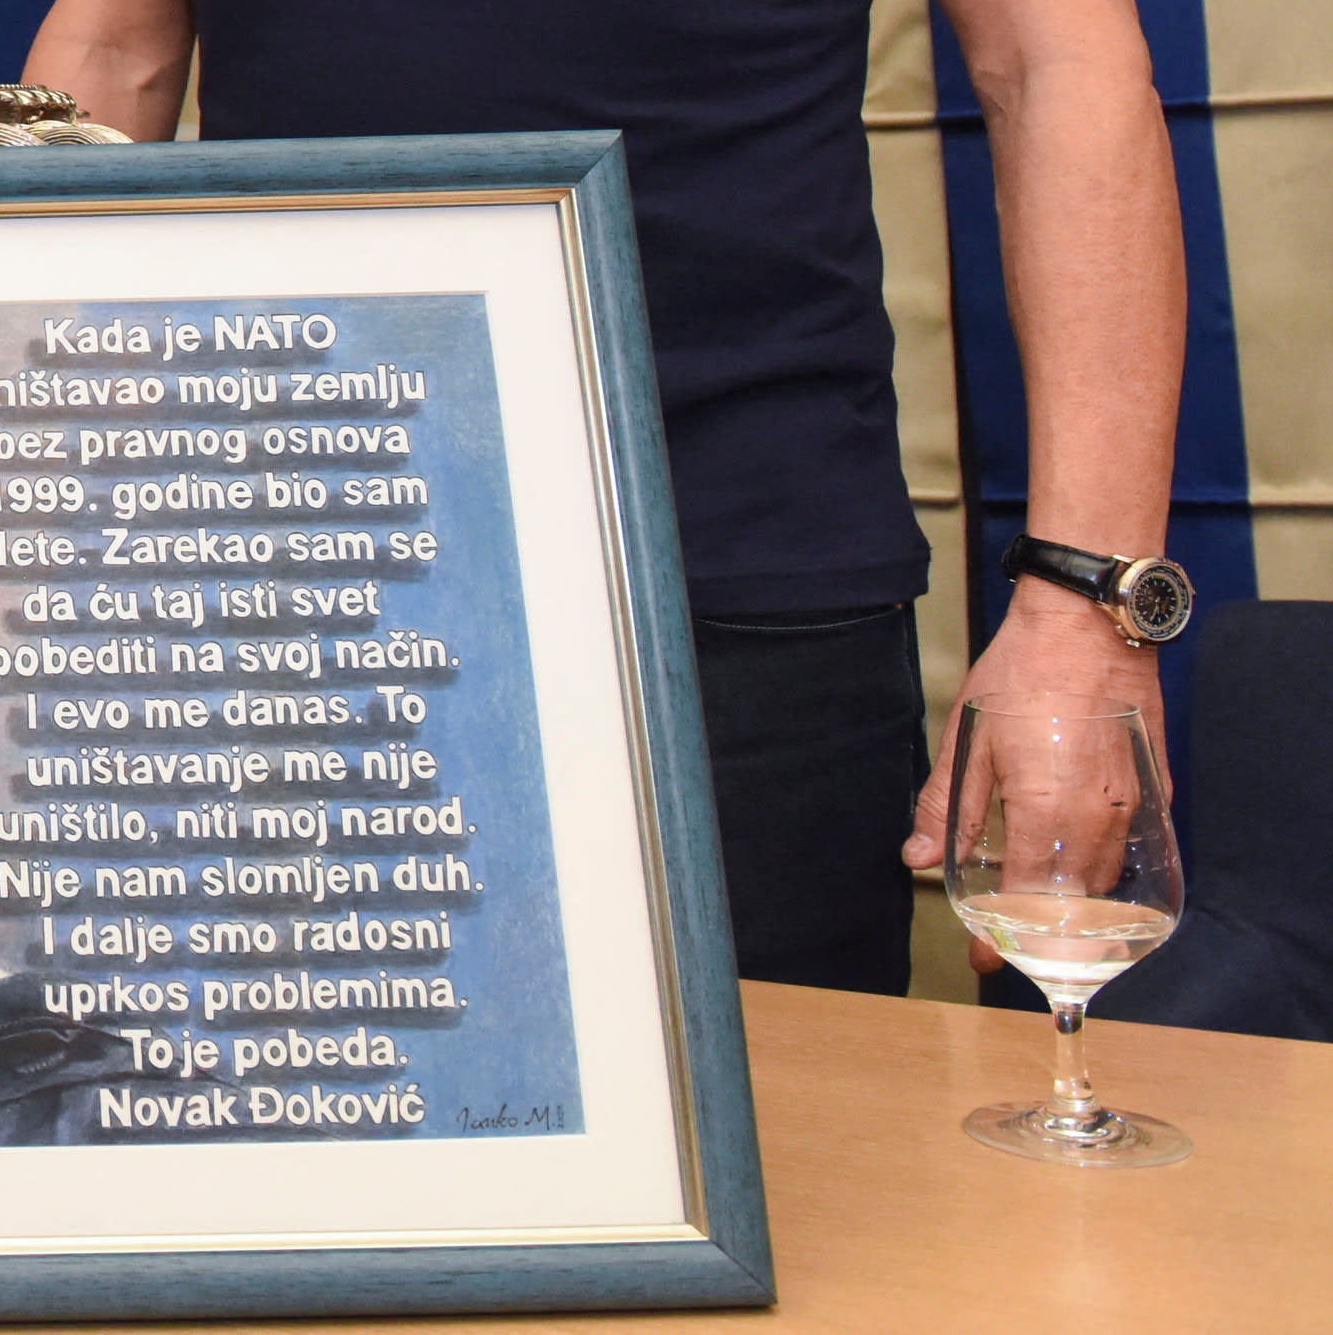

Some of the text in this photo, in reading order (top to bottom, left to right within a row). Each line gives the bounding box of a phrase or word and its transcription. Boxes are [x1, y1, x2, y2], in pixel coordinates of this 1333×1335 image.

[44, 313, 337, 362] Kada je NATO
[178, 368, 277, 411] moju
[290, 363, 426, 409] zemlju
[79, 428, 247, 466] pravnog
[263, 424, 411, 455] osnova
[112, 473, 253, 520] godine
[265, 471, 327, 509] bio
[343, 476, 428, 506] sam
[101, 527, 273, 565] Zarekao
[287, 531, 375, 561] sam
[389, 531, 437, 561] se
[22, 580, 381, 628] da ću taj isti svet
[171, 641, 224, 672] na
[237, 633, 322, 679] svoj
[334, 631, 460, 668] način.
[27, 685, 426, 729] I evo me danas. To
[27, 742, 437, 793] uništavanje me nije
[176, 802, 238, 839] niti
[252, 800, 328, 847] moj
[341, 796, 477, 835] narod.
[96, 866, 186, 897] nam
[201, 855, 379, 902] slomljen
[392, 854, 484, 891] duh.
[43, 910, 451, 963] I dalje smo radosni
[45, 970, 468, 1021] uprkos problemima.
[233, 1027, 408, 1077] pobeda.
[99, 1083, 425, 1128] Novak Đoković
